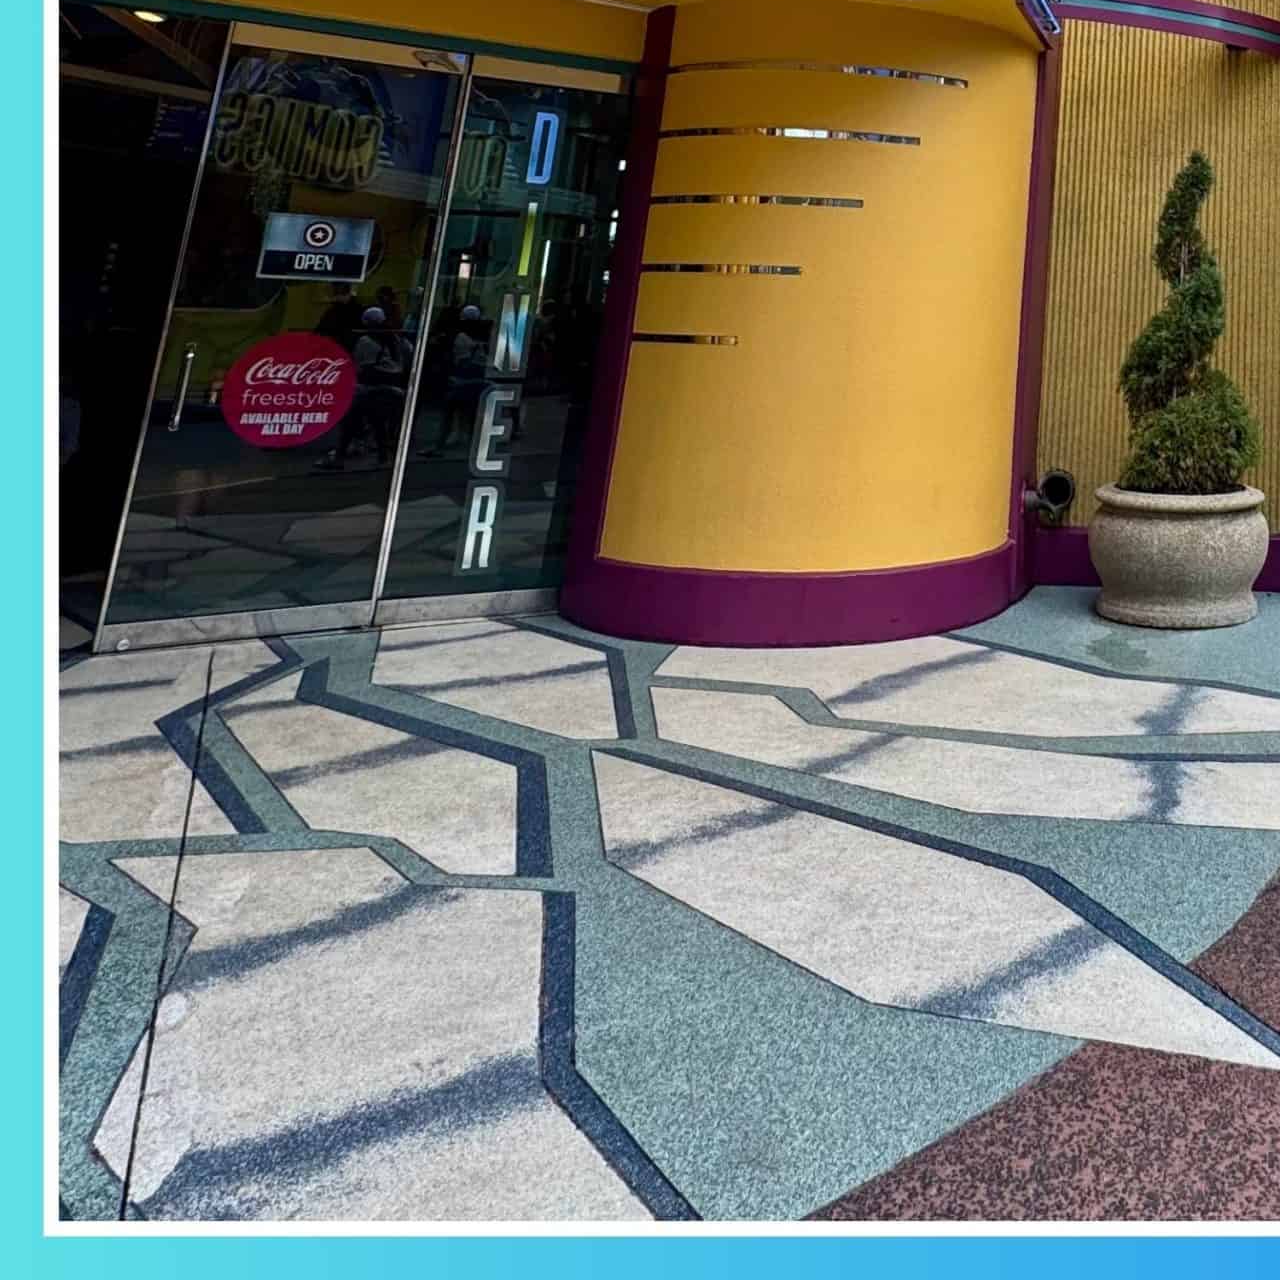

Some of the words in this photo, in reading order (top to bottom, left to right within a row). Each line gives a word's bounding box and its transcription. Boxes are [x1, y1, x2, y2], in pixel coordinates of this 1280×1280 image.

[294, 253, 334, 272] OPEN
[461, 111, 560, 570] DINER
[241, 388, 335, 409] freestyle
[239, 412, 299, 425] AVAILABLE
[301, 412, 329, 424] HERE
[261, 424, 281, 436] ALL
[282, 423, 305, 436] DAY
